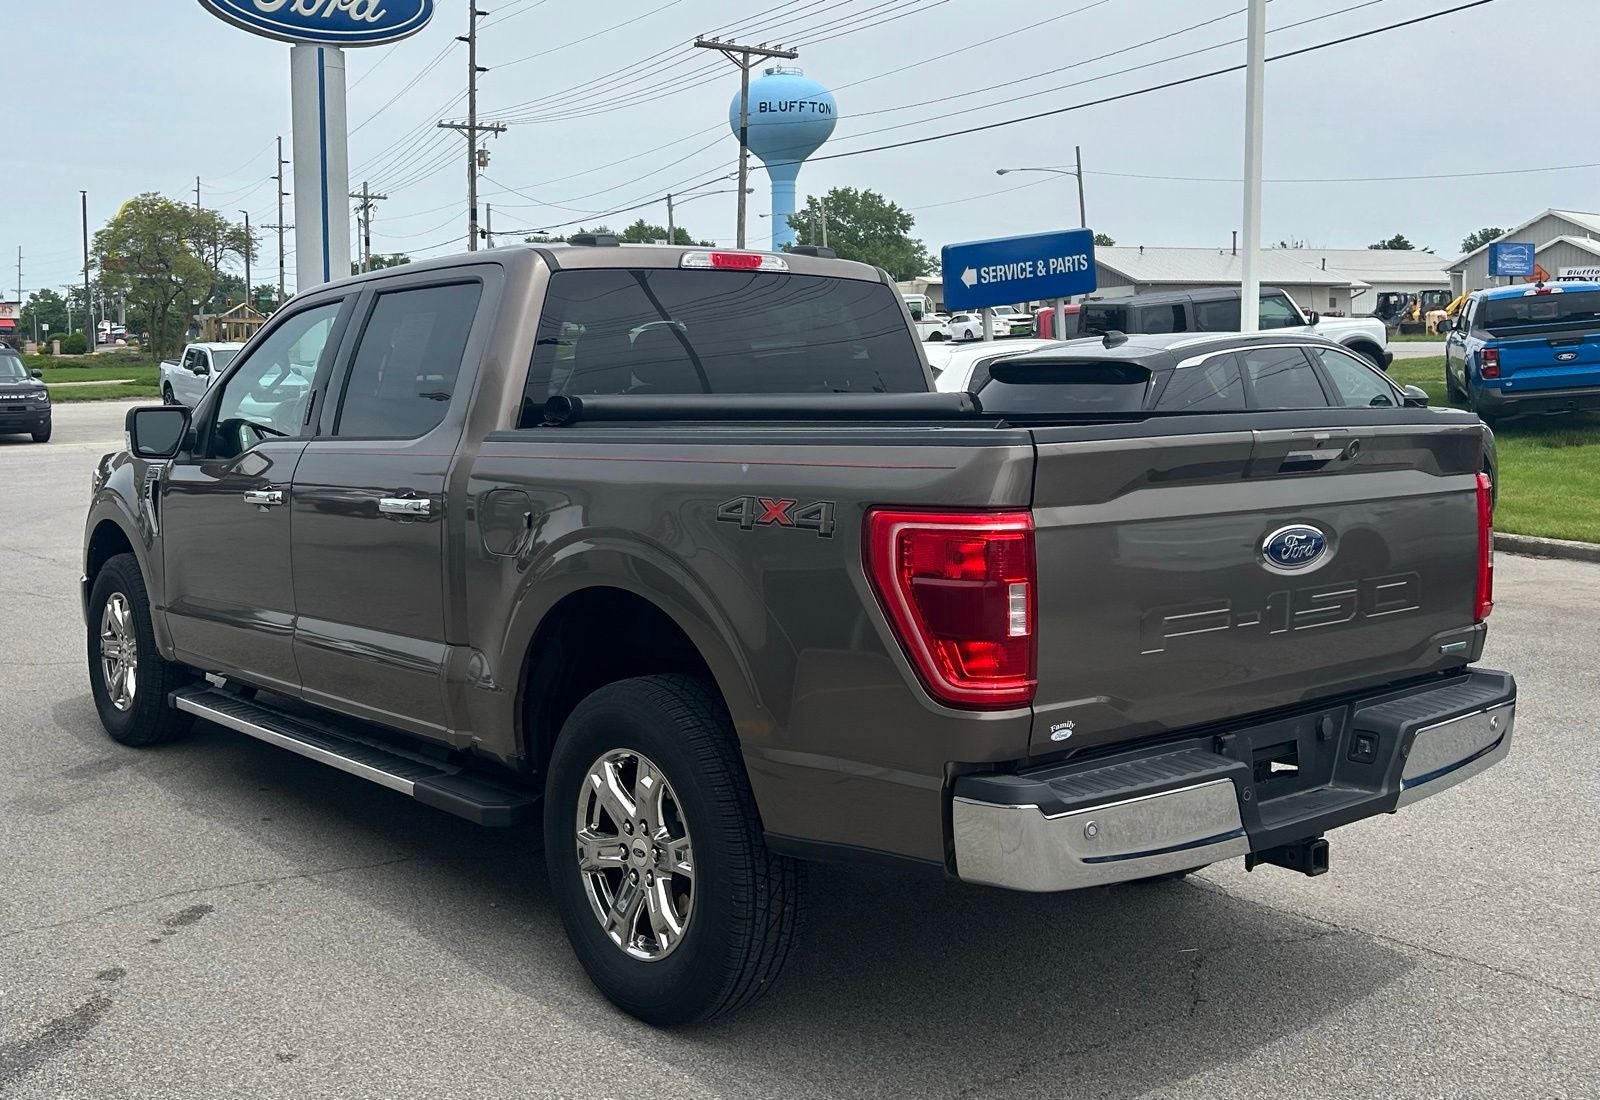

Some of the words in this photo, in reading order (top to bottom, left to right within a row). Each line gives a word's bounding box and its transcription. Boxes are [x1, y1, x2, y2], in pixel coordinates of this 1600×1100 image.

[254, 0, 386, 22] ord
[759, 101, 831, 115] BLUFFTON
[981, 262, 1033, 284] SERVICE
[1037, 260, 1046, 276] &
[1049, 254, 1088, 275] PARTS
[1281, 534, 1316, 560] Ford
[1138, 571, 1421, 655] F-150
[1050, 720, 1075, 732] Family
